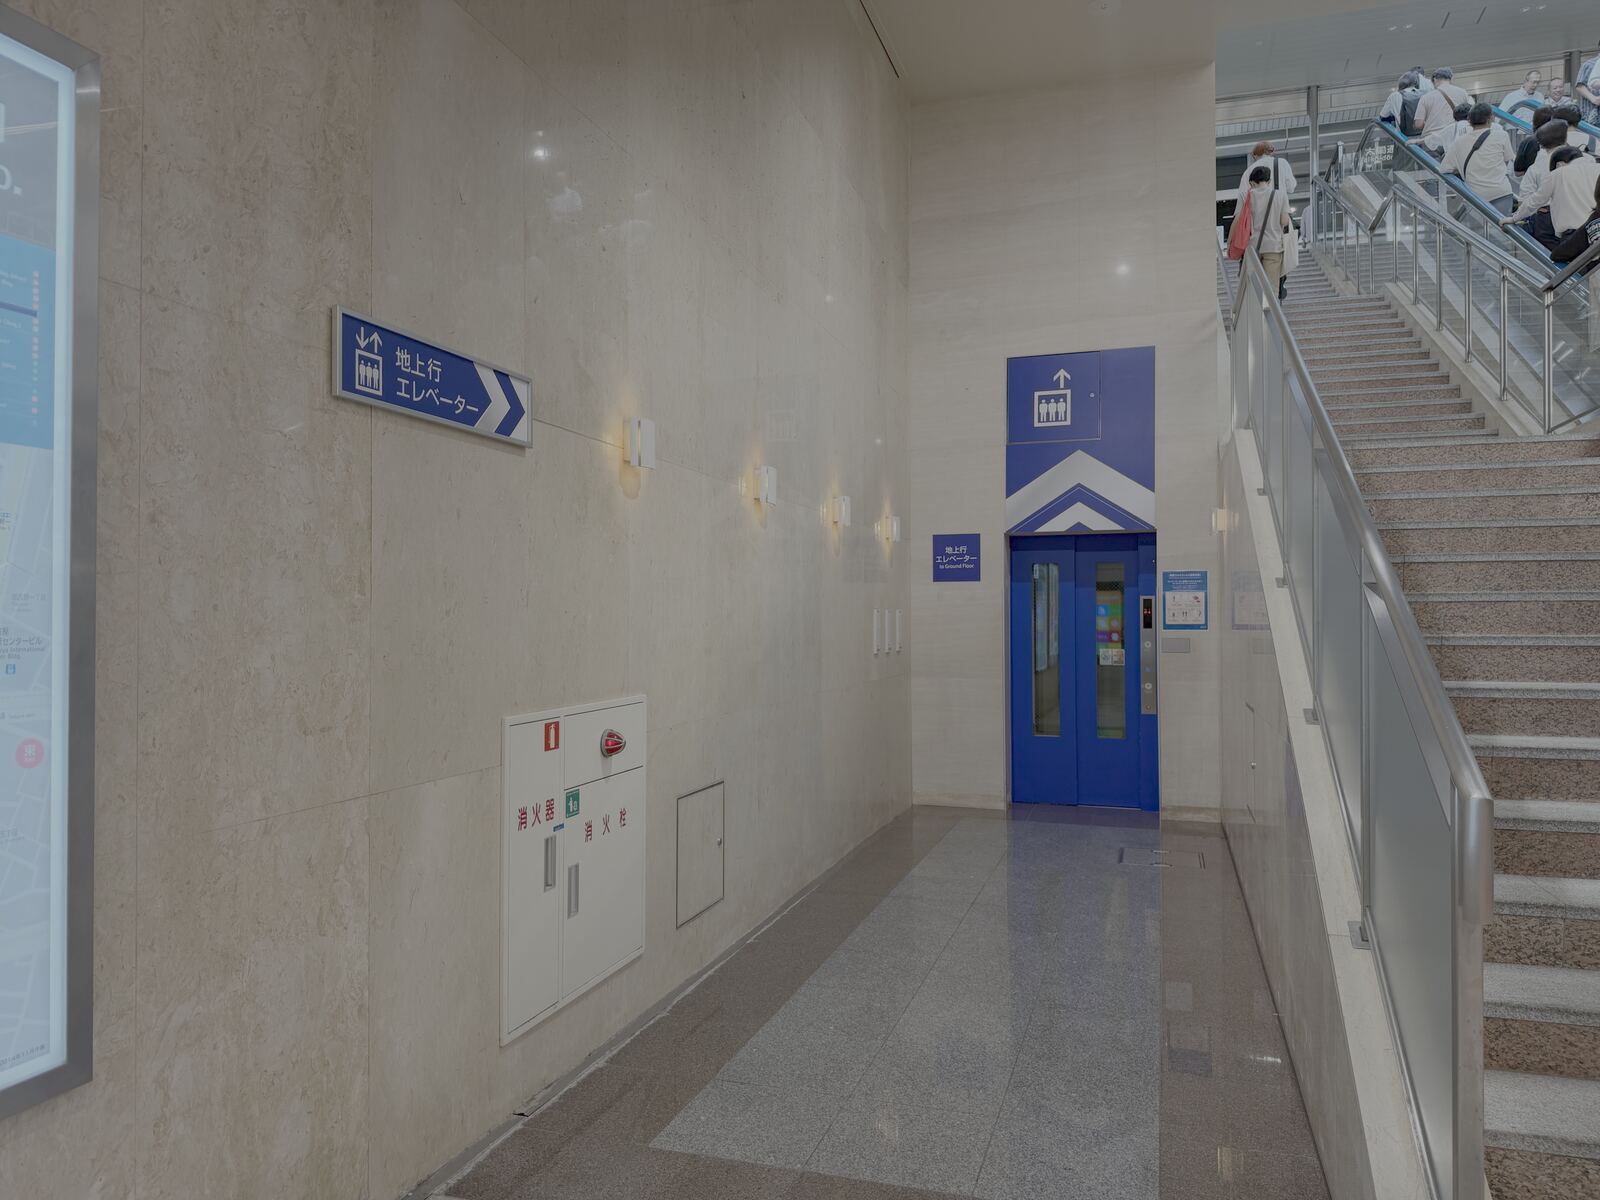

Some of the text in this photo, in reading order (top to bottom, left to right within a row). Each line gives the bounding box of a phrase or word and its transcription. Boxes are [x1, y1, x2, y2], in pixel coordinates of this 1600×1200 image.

[395, 346, 442, 383] 地上行
[396, 377, 479, 415] エレベーター
[935, 555, 977, 563] エレベーター
[945, 545, 967, 554] 地上行
[517, 798, 555, 832] 消火器
[585, 807, 627, 843] 消火栓
